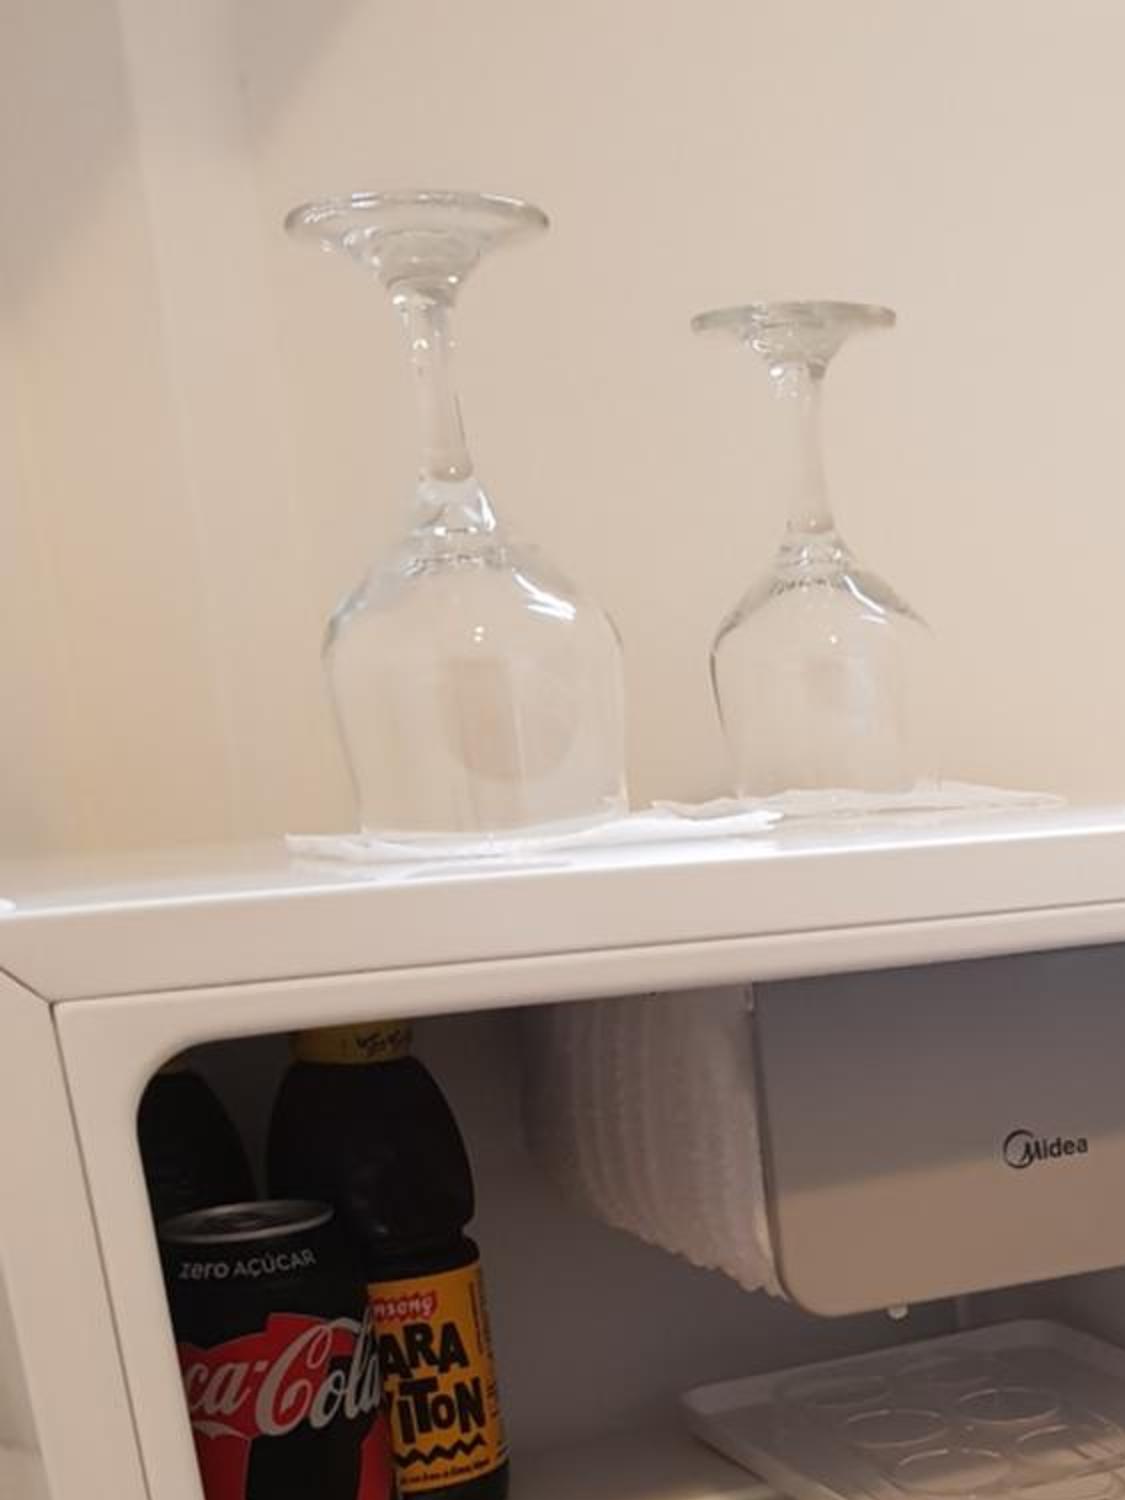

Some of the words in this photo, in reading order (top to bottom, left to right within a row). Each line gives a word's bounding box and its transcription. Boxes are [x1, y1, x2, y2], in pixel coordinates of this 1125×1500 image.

[1003, 1129, 1089, 1168] Midea
[179, 1261, 230, 1279] zero
[233, 1249, 317, 1277] AÇÚCAR
